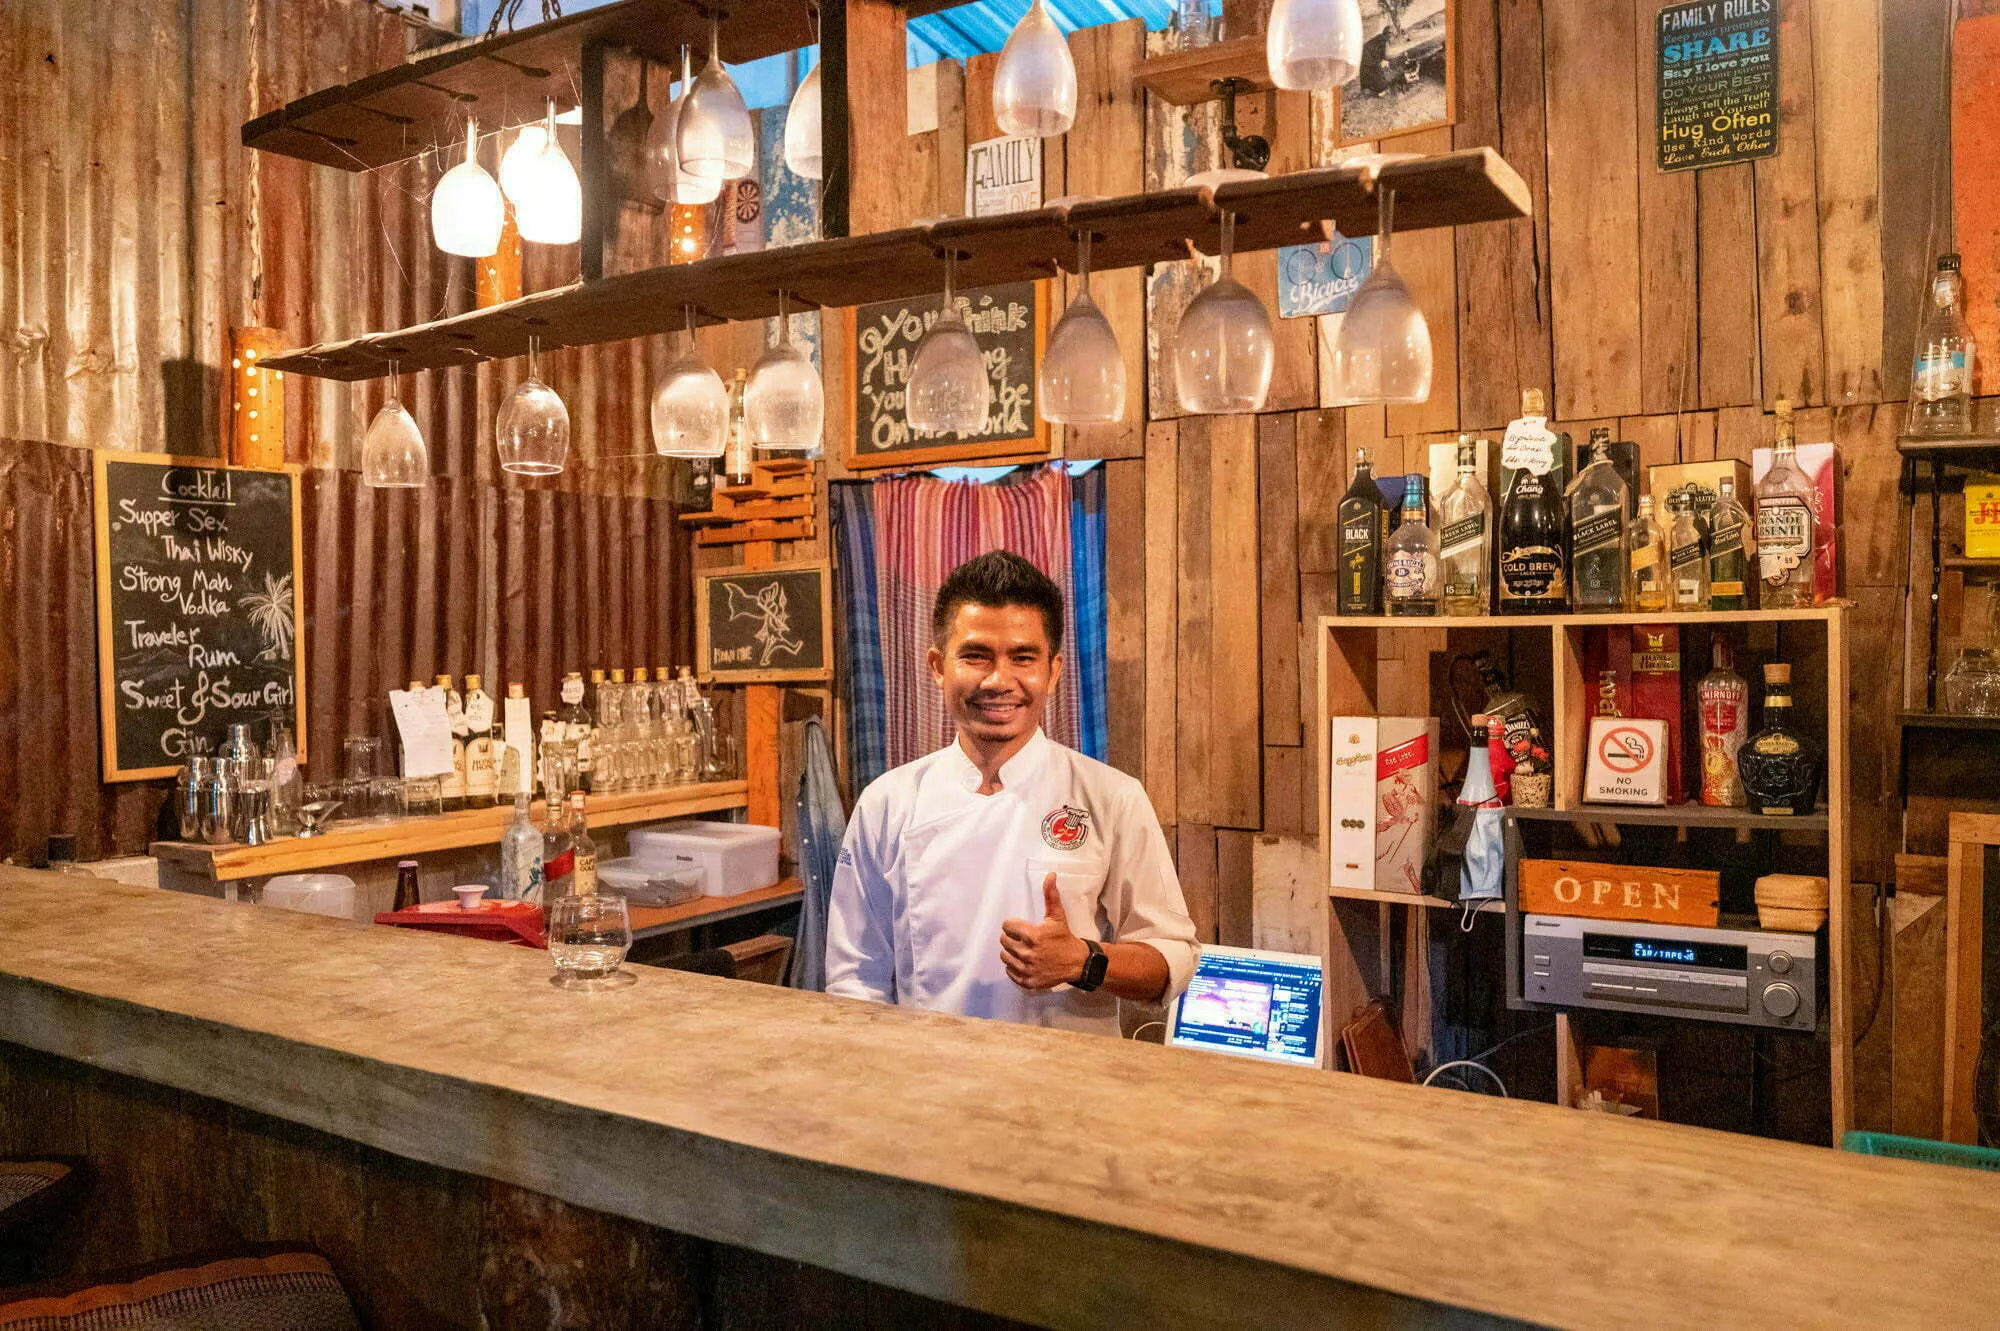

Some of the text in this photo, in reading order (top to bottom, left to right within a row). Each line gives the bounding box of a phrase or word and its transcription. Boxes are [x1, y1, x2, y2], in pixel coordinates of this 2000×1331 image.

[1662, 0, 1771, 32] FAMILY RULES
[1663, 27, 1772, 64] SHARE
[1663, 68, 1693, 80] Say
[1695, 64, 1702, 74] I
[1705, 60, 1738, 73] love
[1740, 54, 1770, 67] you
[1662, 72, 1771, 100] DO YOUR BEST
[1663, 90, 1770, 116] Always Tell the Truth
[1664, 101, 1770, 124] Laugh at Yourself
[1662, 112, 1771, 141] Hug Often
[1663, 129, 1771, 153] Use Kind Words
[1664, 140, 1771, 164] Love Each Other
[971, 136, 1038, 214] FAMILY
[1515, 484, 1544, 496] Chang
[119, 498, 228, 537] Supper Sex
[1595, 519, 1617, 532] LABEL
[1758, 516, 1801, 526] RANDE
[1345, 528, 1369, 540] BLACK
[1441, 528, 1460, 541] GREEN
[1460, 521, 1480, 533] LABEL
[1758, 525, 1803, 537] BSENTE
[161, 535, 253, 573] Thai Wisky
[1503, 562, 1556, 573] COLD BREW
[119, 565, 182, 602] Strong
[1445, 586, 1455, 594] 15
[179, 590, 231, 622] Vodka
[124, 619, 201, 650] Traveler
[188, 643, 241, 669] Rum
[211, 675, 262, 708] Sour
[263, 675, 294, 705] Girl
[160, 727, 214, 758] Gin
[1599, 785, 1649, 797] SMOKING
[1616, 776, 1632, 785] NO
[1553, 876, 1681, 910] OPEN
